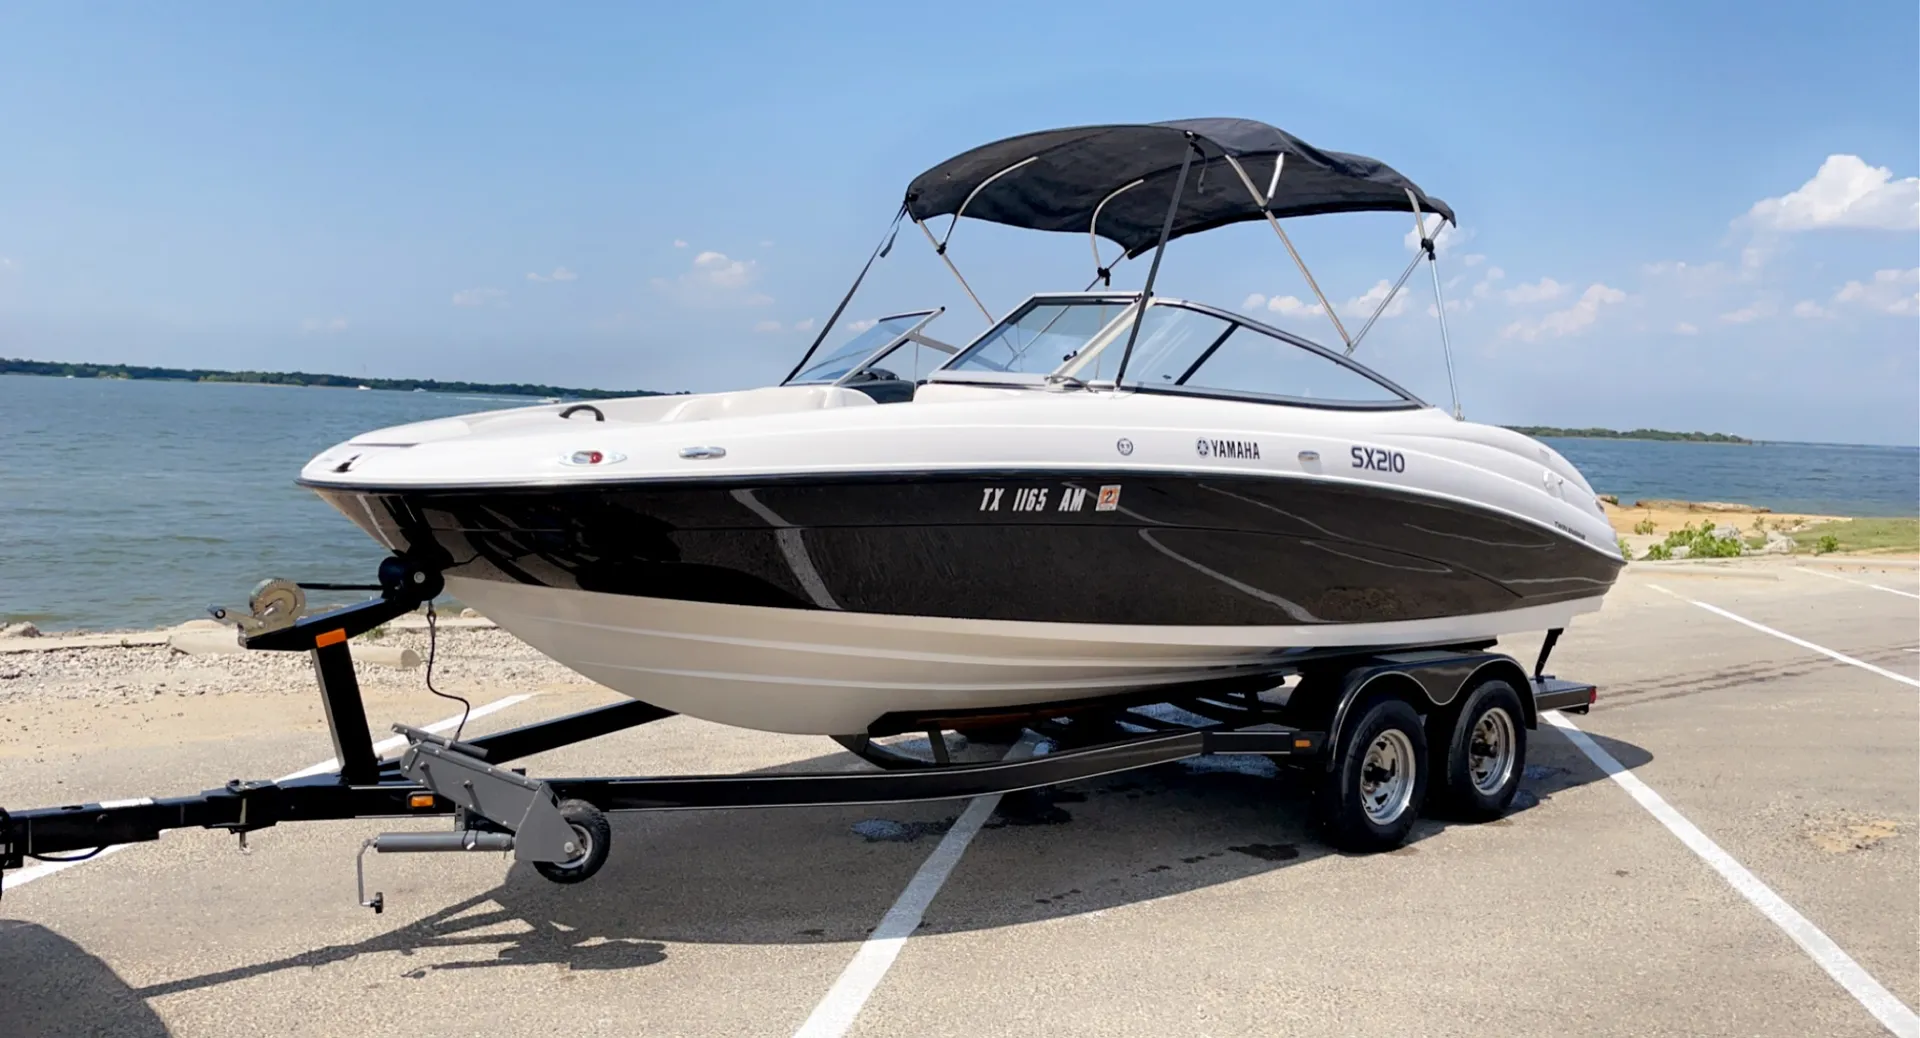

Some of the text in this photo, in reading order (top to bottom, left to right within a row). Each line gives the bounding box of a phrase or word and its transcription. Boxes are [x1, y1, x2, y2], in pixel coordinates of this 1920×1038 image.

[1211, 439, 1260, 459] YAMAHA
[1351, 446, 1405, 473] SX210
[979, 488, 1087, 511] TX 1165 AM
